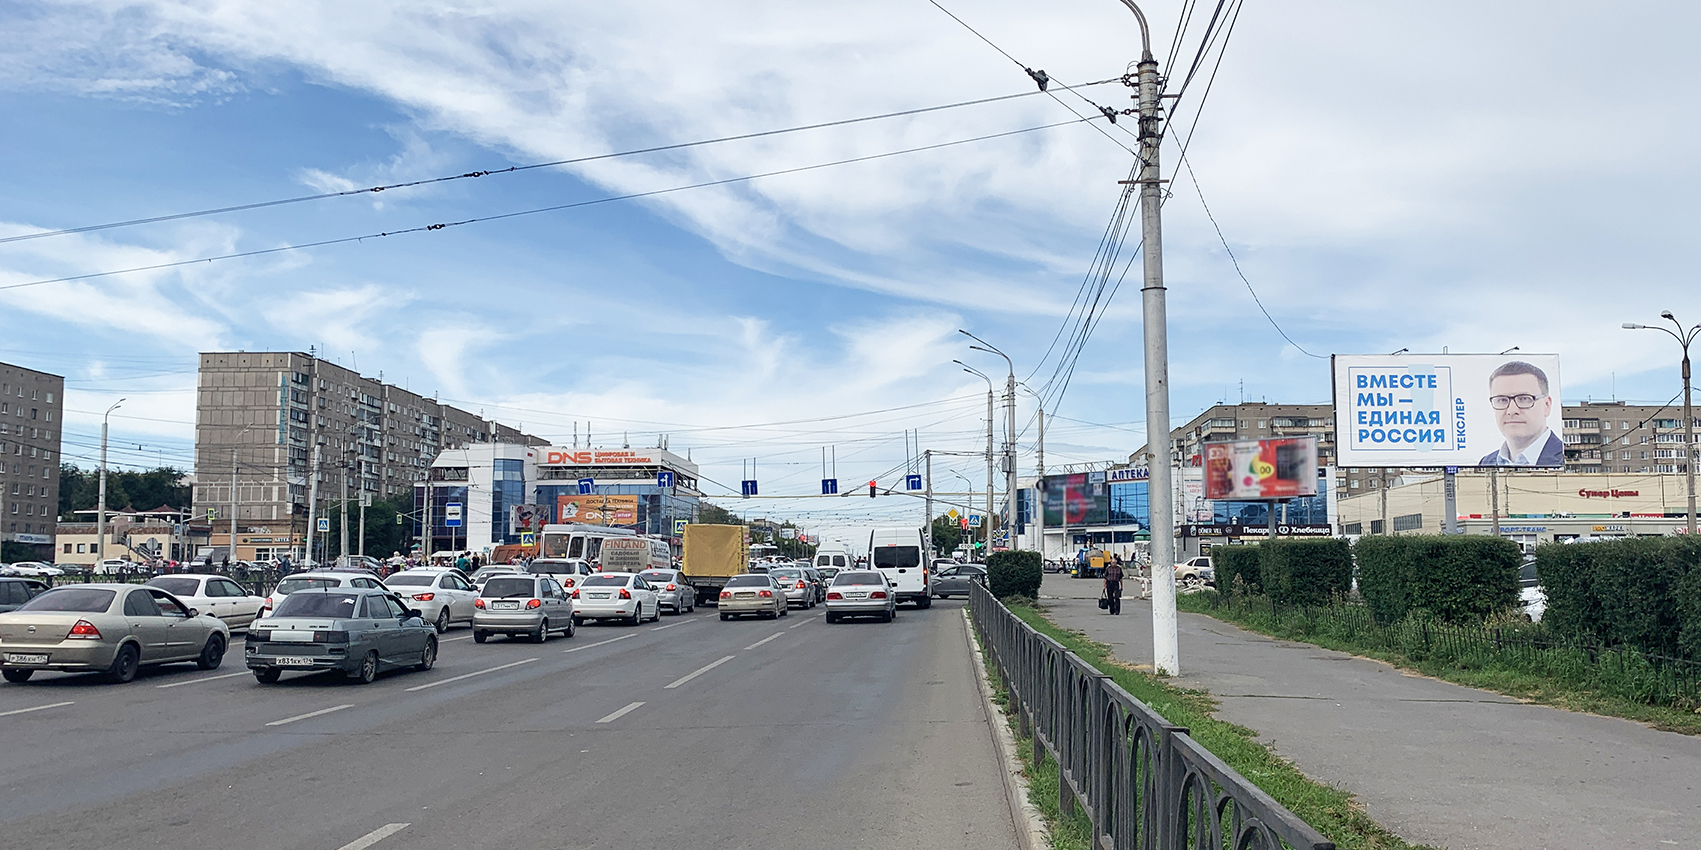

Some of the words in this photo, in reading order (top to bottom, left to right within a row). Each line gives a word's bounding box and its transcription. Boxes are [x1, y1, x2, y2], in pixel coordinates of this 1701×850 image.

[1356, 374, 1437, 389] ВМЕСТЕ
[1356, 392, 1393, 407] МЫ
[278, 375, 288, 445] АПТЕКА
[1357, 410, 1441, 427] ЕДИНАЯ
[1455, 397, 1466, 451] ТЕКСЛЕР
[1358, 428, 1445, 443] РОССИЯ
[547, 452, 592, 464] DNS
[1112, 467, 1149, 480] АПТЕКА
[1578, 488, 1610, 498] Супер
[1611, 489, 1639, 498] Цены
[1290, 526, 1330, 535] Хлебница
[604, 540, 646, 549] FINLAND
